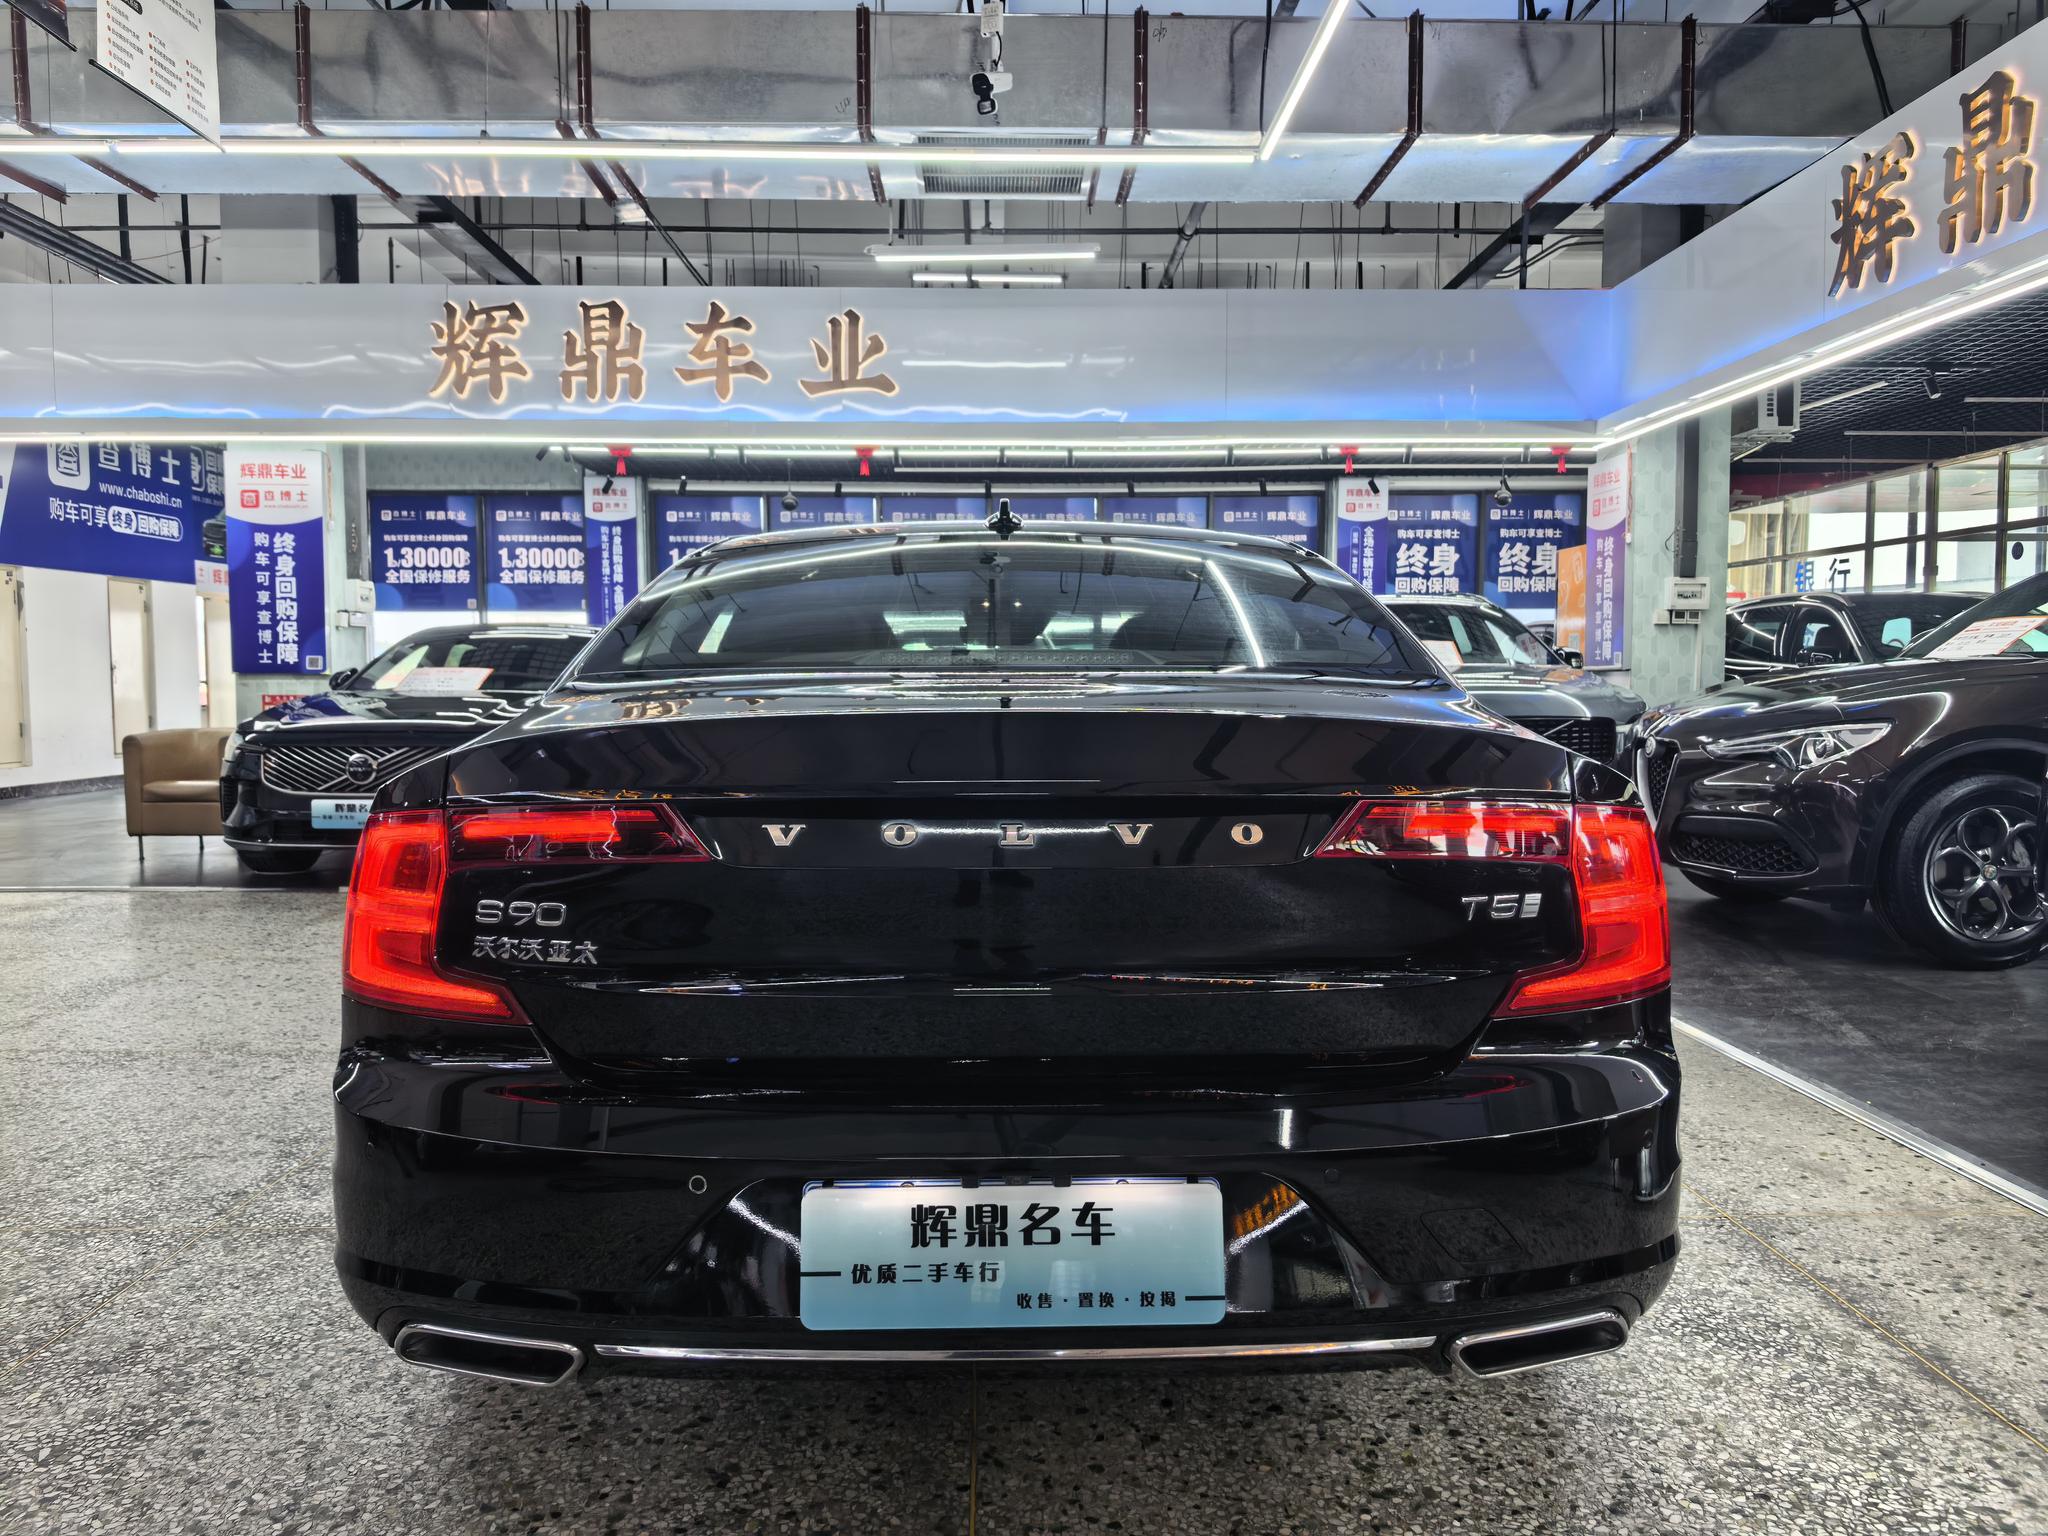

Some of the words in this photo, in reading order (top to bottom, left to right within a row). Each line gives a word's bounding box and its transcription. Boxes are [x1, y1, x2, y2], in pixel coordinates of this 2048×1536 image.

[1828, 71, 2036, 297] 辉鼎
[429, 300, 899, 402] 辉鼎车业
[240, 463, 307, 479] 辉鼎车业
[99, 482, 183, 509] www.chaboshi.cn
[1396, 543, 1460, 576] 终身
[1499, 542, 1557, 575] 终身
[385, 569, 470, 584] 全国保修服务
[500, 569, 584, 584] 全国保修服务
[1395, 577, 1459, 593] 回购保障
[254, 532, 273, 663] 购车可享查博士
[273, 532, 299, 664] 终身回购保障
[762, 823, 1263, 846] VOLVO
[475, 899, 566, 926] S90
[1461, 894, 1519, 920] T5
[472, 935, 598, 964] 沃尔沃亚太
[911, 1201, 1115, 1248] 辉鼎名车
[851, 1263, 1000, 1284] 优质二手车行
